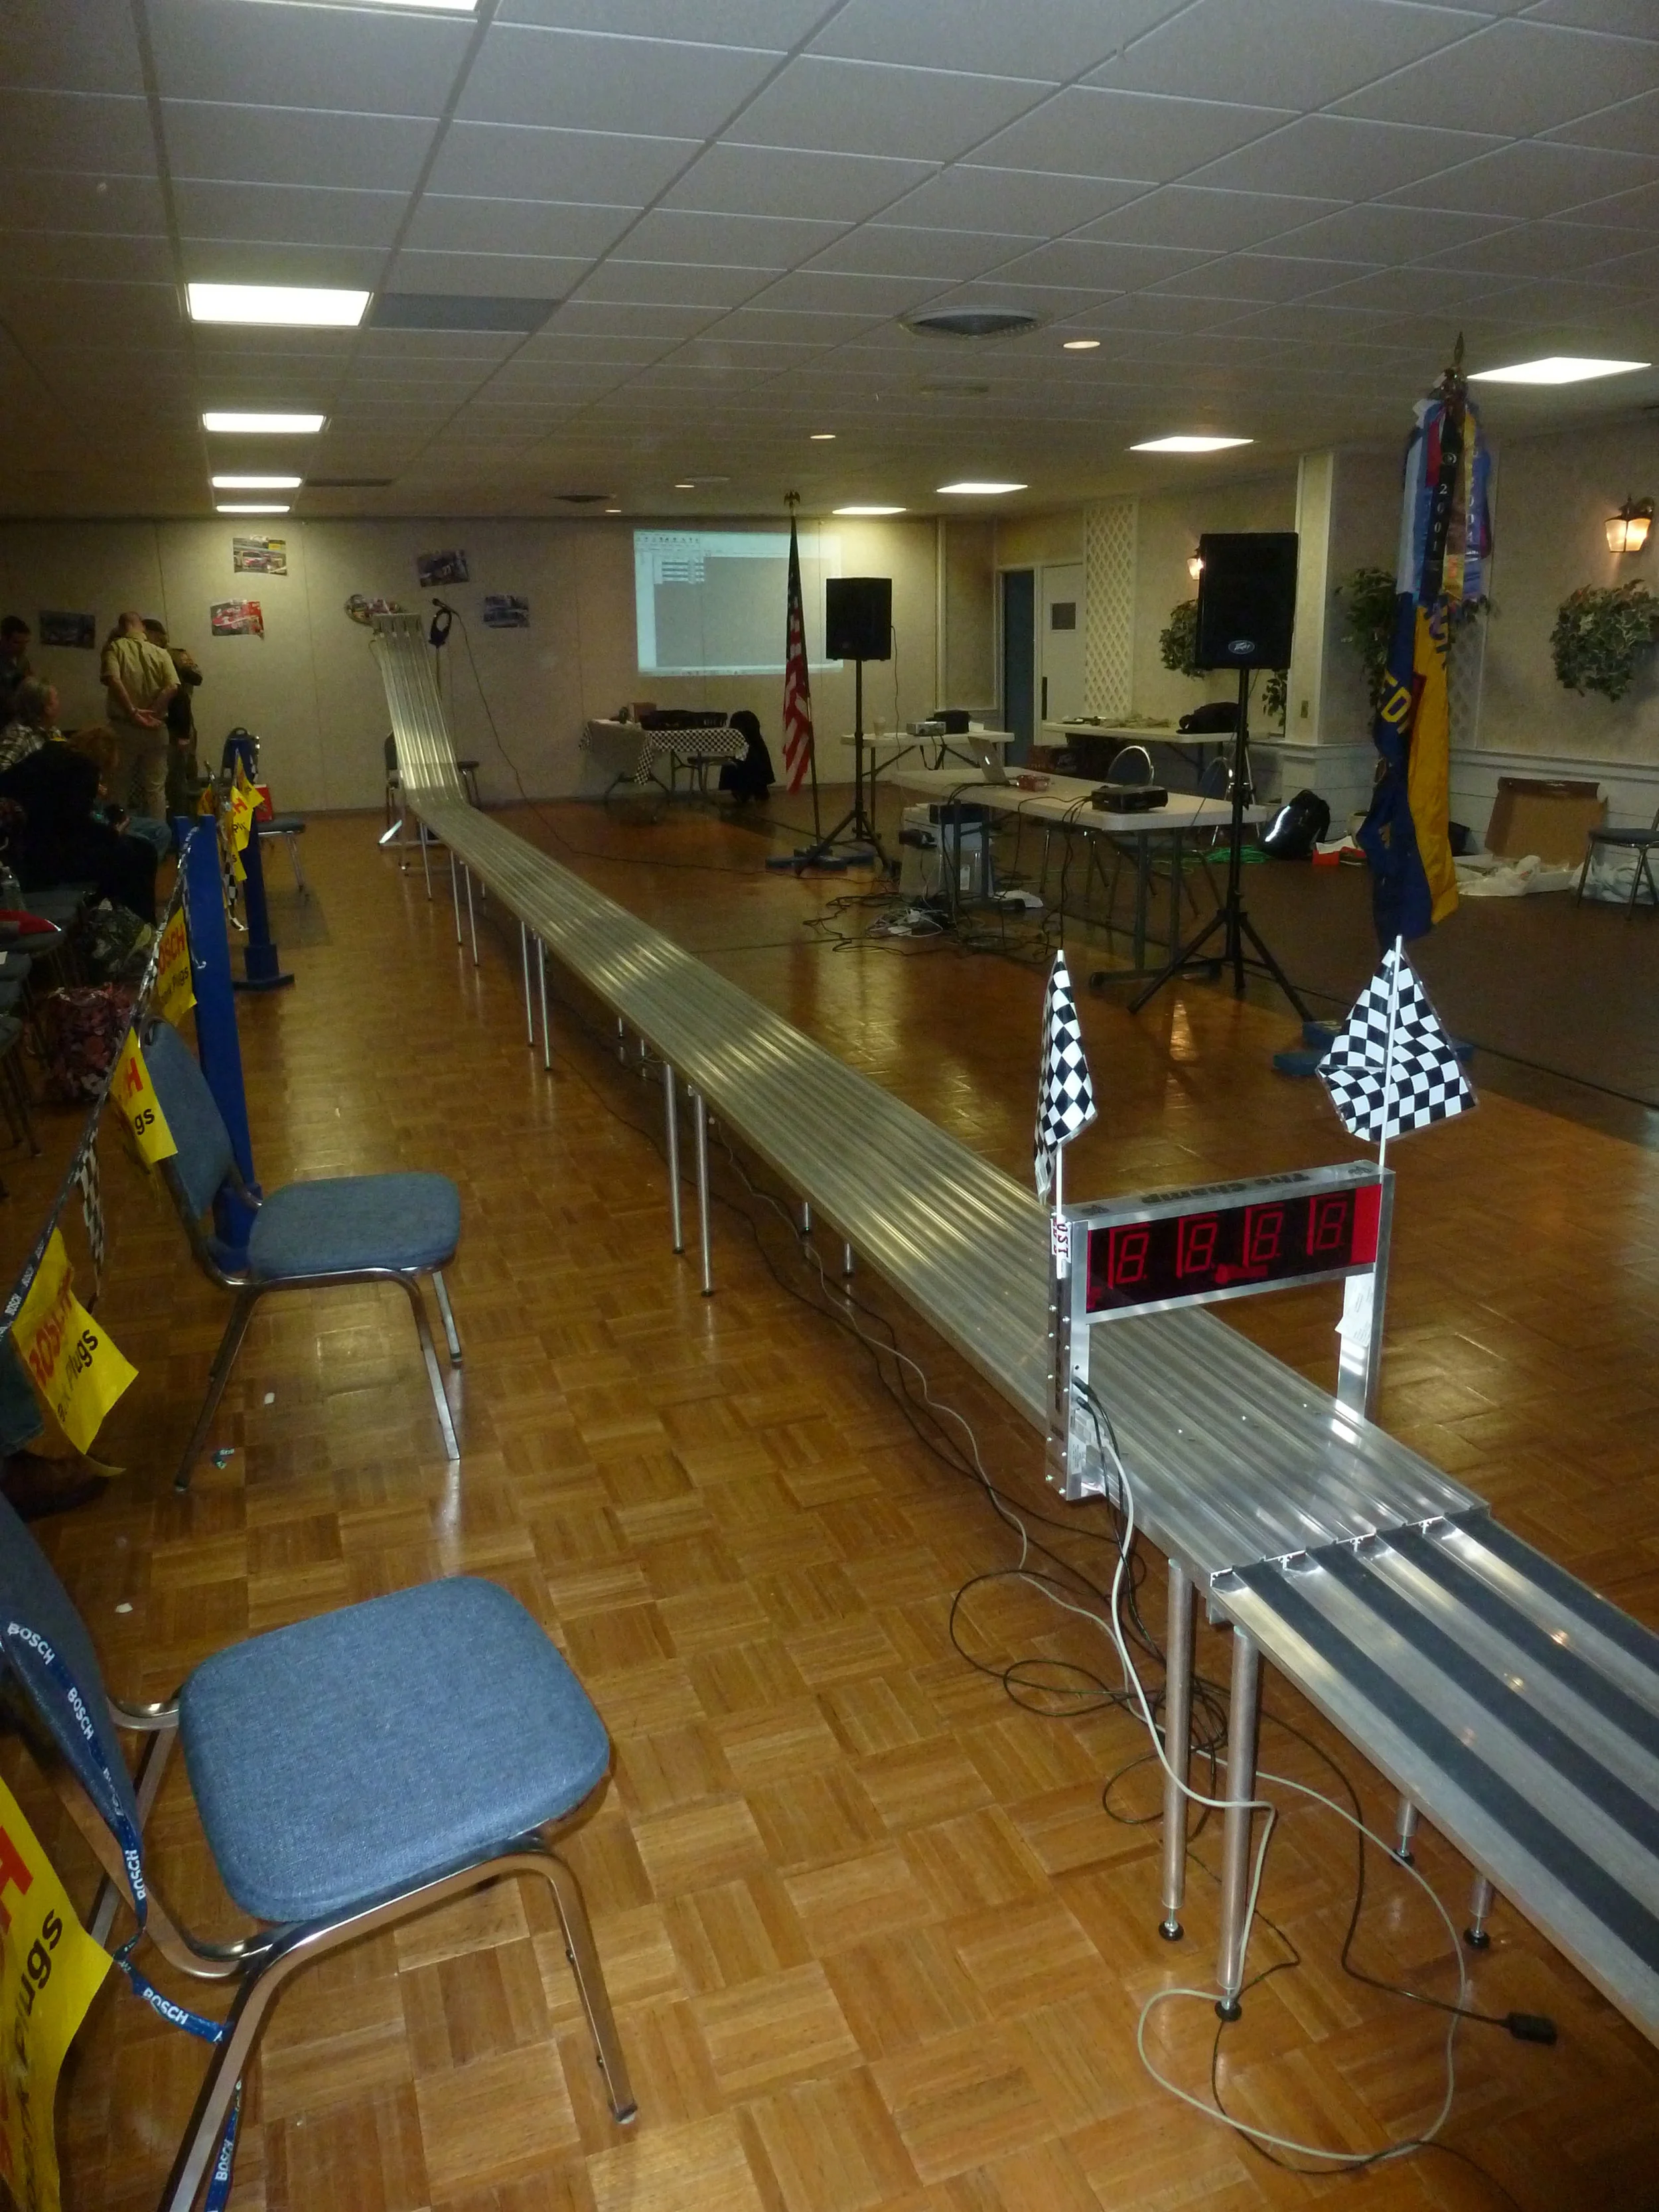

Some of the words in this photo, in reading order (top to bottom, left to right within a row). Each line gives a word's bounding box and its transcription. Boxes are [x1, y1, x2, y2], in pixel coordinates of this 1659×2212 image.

[7, 1622, 56, 1665] BOSCH
[67, 1686, 94, 1740] BOSCH
[125, 1848, 147, 1901] BOSCH
[143, 1987, 189, 2025] BOSCH
[214, 2138, 234, 2181] BOSCH
